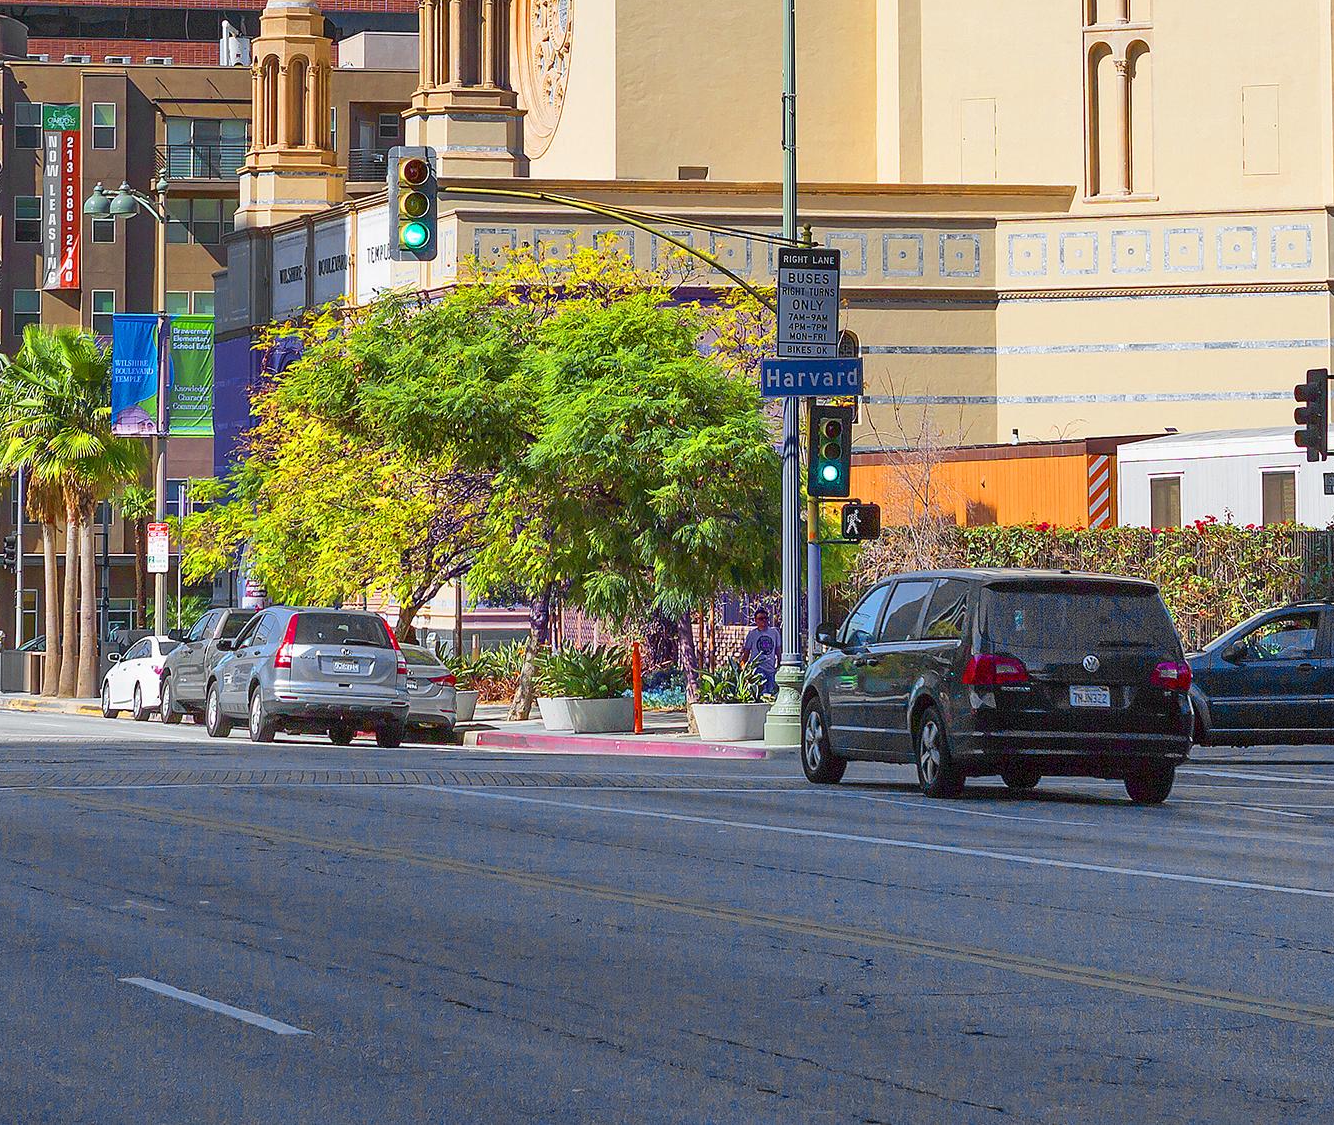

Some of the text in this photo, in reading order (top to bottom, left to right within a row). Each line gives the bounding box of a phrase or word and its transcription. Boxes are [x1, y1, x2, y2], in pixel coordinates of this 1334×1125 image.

[47, 135, 59, 284] NOW LEASING
[64, 136, 75, 282] 213-386-2100
[783, 255, 835, 265] RIGHT LANE
[788, 272, 830, 284] BUSES
[782, 286, 835, 297] RIGHT TURNS
[792, 299, 825, 310] ONLY
[788, 312, 828, 321] 7AM-9AM
[788, 323, 828, 331] 4PM-7PM
[173, 335, 211, 343] Elementary
[789, 332, 827, 341] MON-FRI
[787, 345, 828, 354] BIKES OK
[114, 359, 149, 367] WILSHIRE
[115, 367, 154, 375] BOULEVARD
[115, 375, 142, 383] TEMPLE
[766, 367, 858, 388] Harvard
[177, 393, 209, 401] Character
[172, 402, 209, 411] Community
